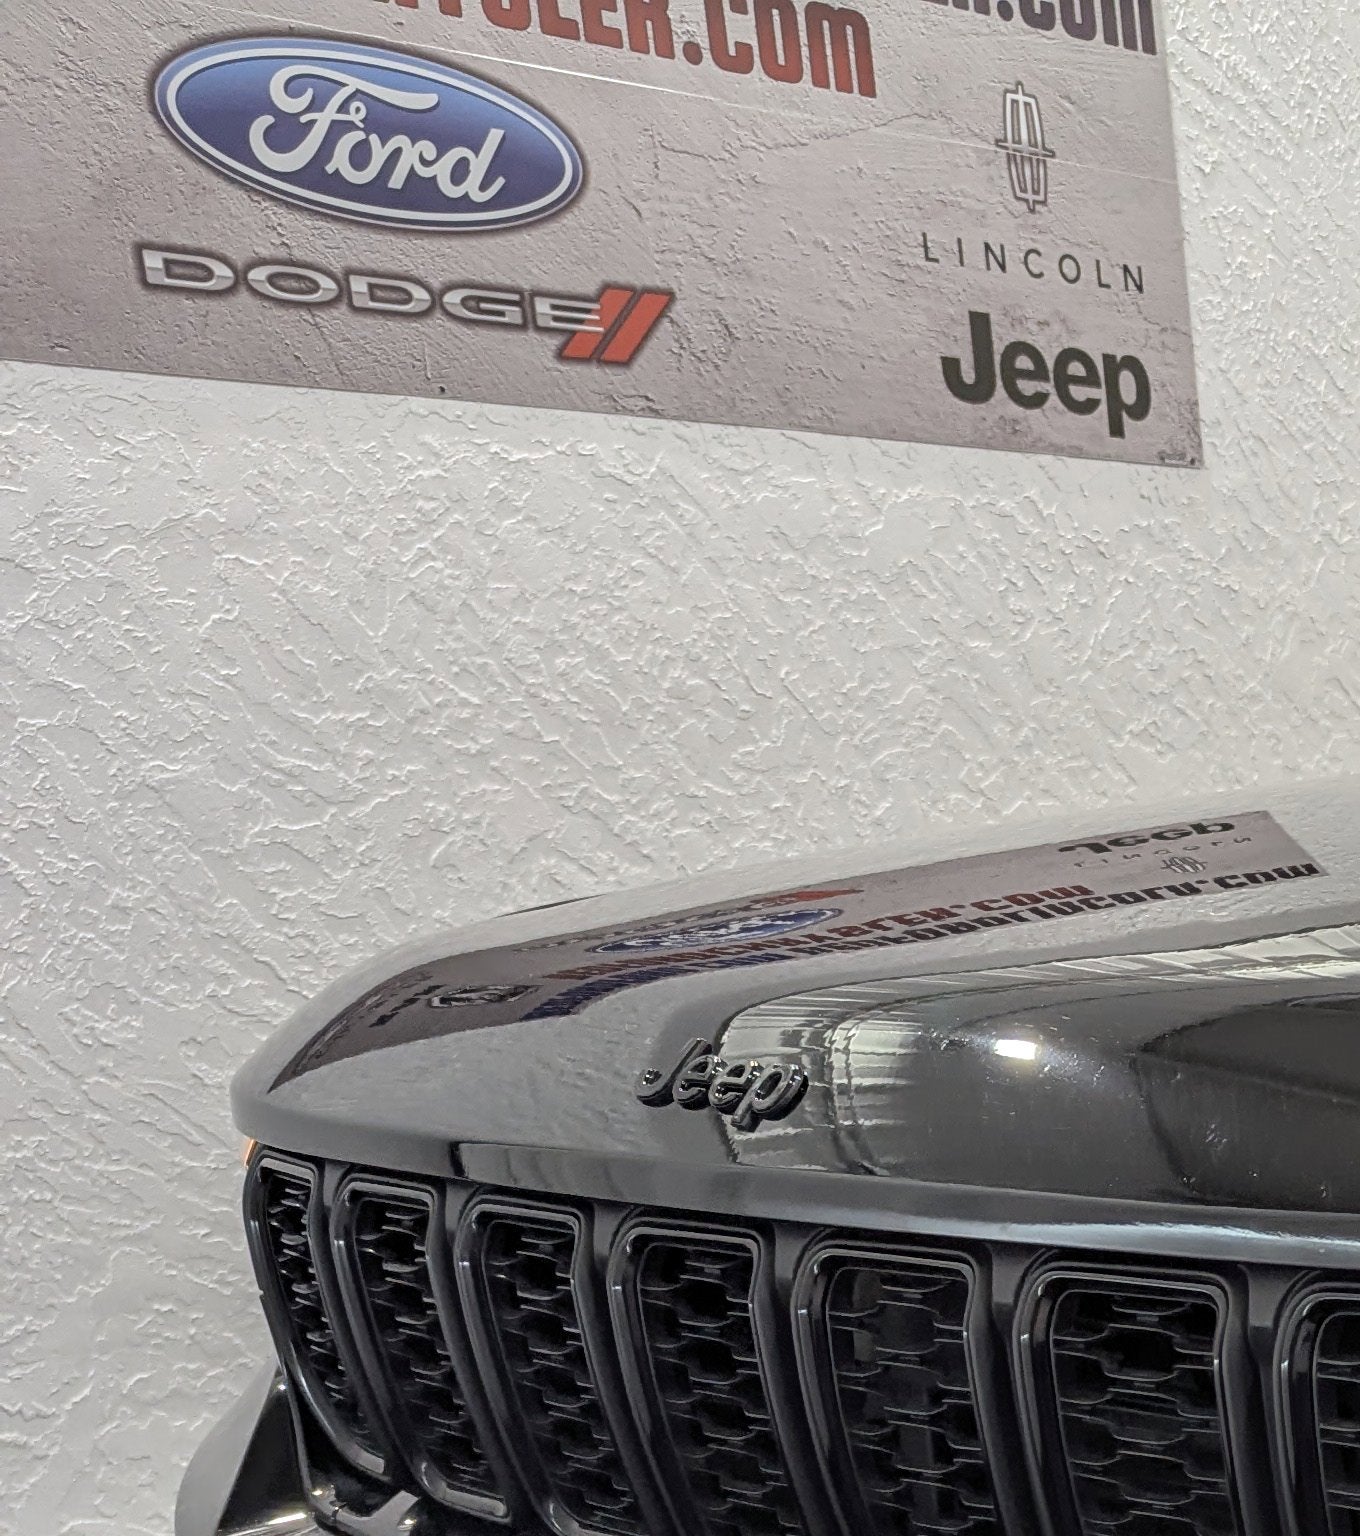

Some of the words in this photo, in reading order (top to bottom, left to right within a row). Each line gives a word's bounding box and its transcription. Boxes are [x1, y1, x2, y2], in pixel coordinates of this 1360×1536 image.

[249, 64, 504, 203] Ford
[141, 248, 604, 333] DODGE
[922, 232, 1146, 294] LINCOLN
[940, 310, 1151, 439] Jeep
[635, 1038, 809, 1132] Jeep
